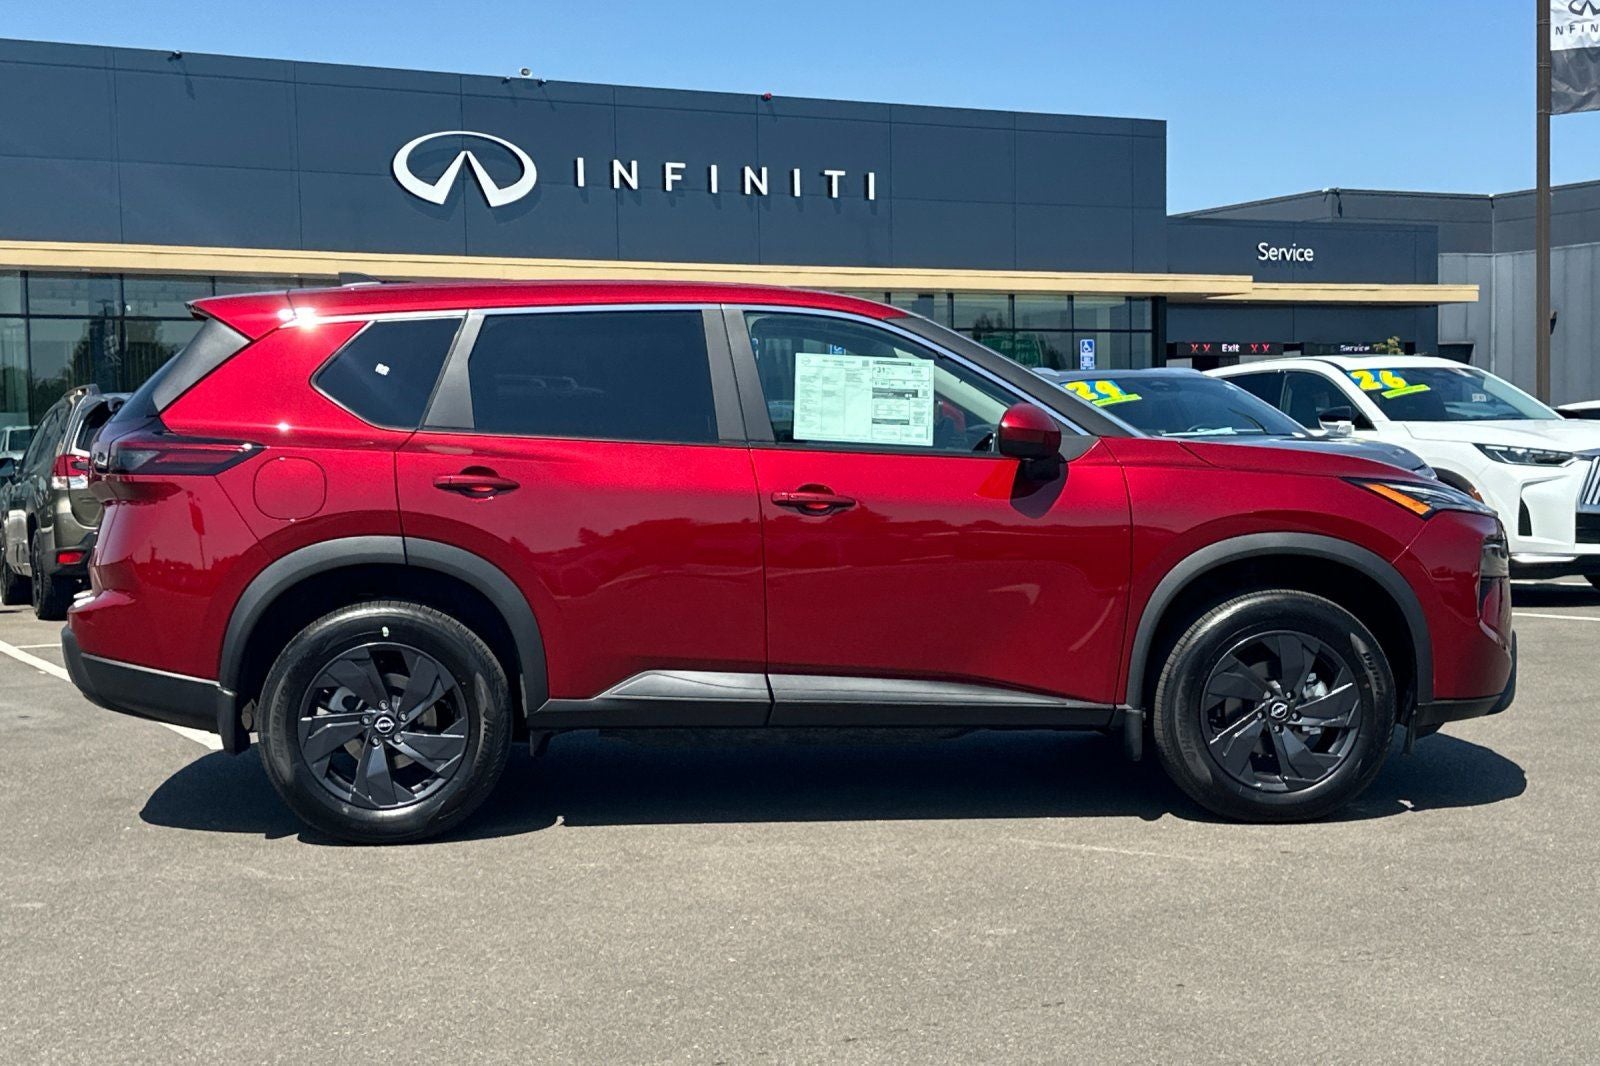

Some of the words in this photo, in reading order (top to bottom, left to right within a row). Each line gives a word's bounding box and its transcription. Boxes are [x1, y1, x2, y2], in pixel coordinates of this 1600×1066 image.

[1555, 24, 1599, 35] NFIN
[576, 157, 876, 200] INFINITI
[1257, 242, 1314, 262] Service
[1221, 343, 1240, 353] Exit
[1350, 370, 1407, 391] 26
